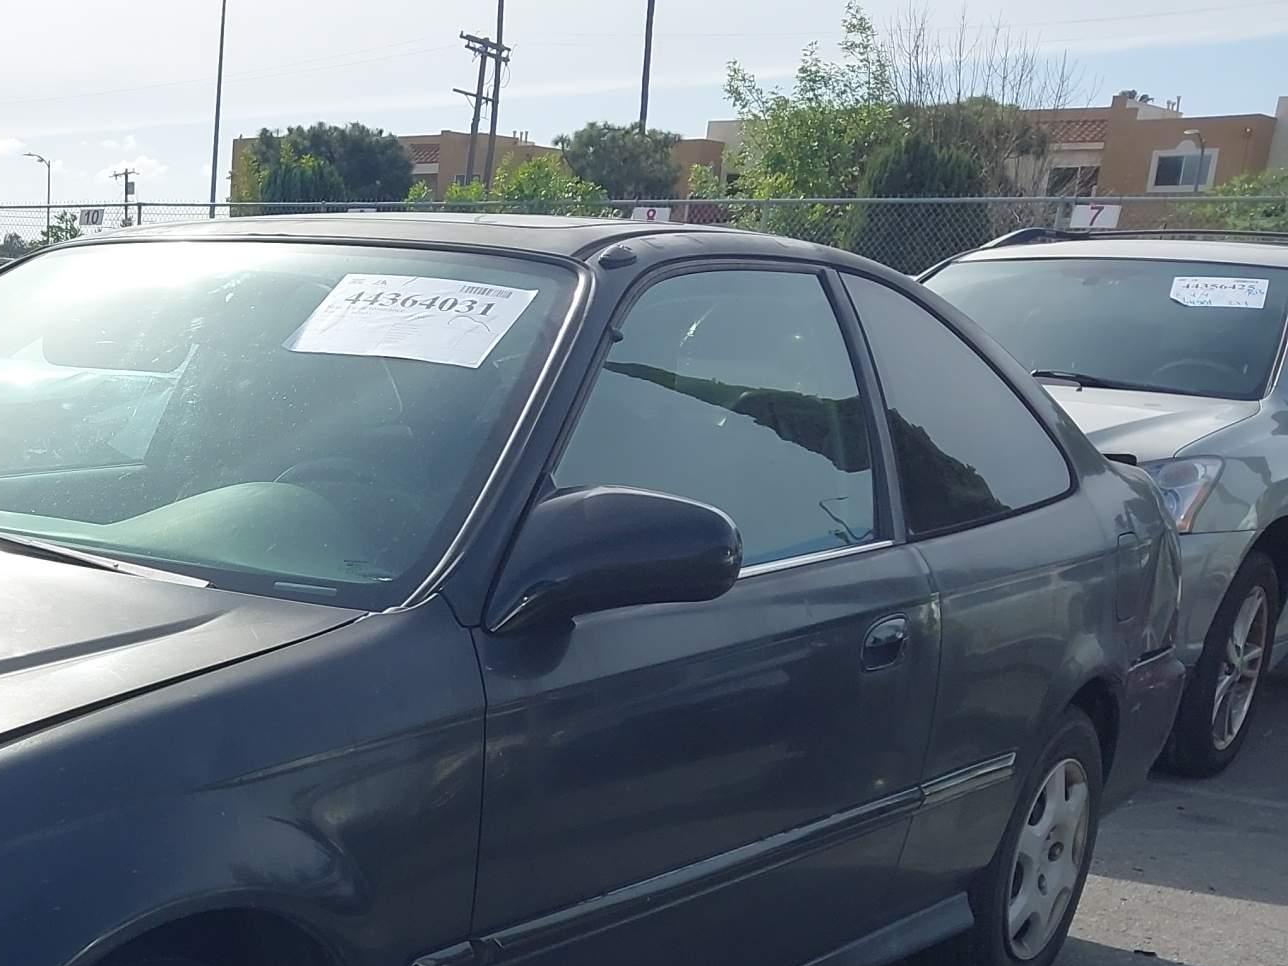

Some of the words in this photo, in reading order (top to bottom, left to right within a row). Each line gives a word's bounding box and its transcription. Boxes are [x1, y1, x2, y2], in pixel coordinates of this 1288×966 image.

[84, 209, 100, 225] 10
[1089, 206, 1105, 226] 7
[344, 291, 497, 316] 44364031
